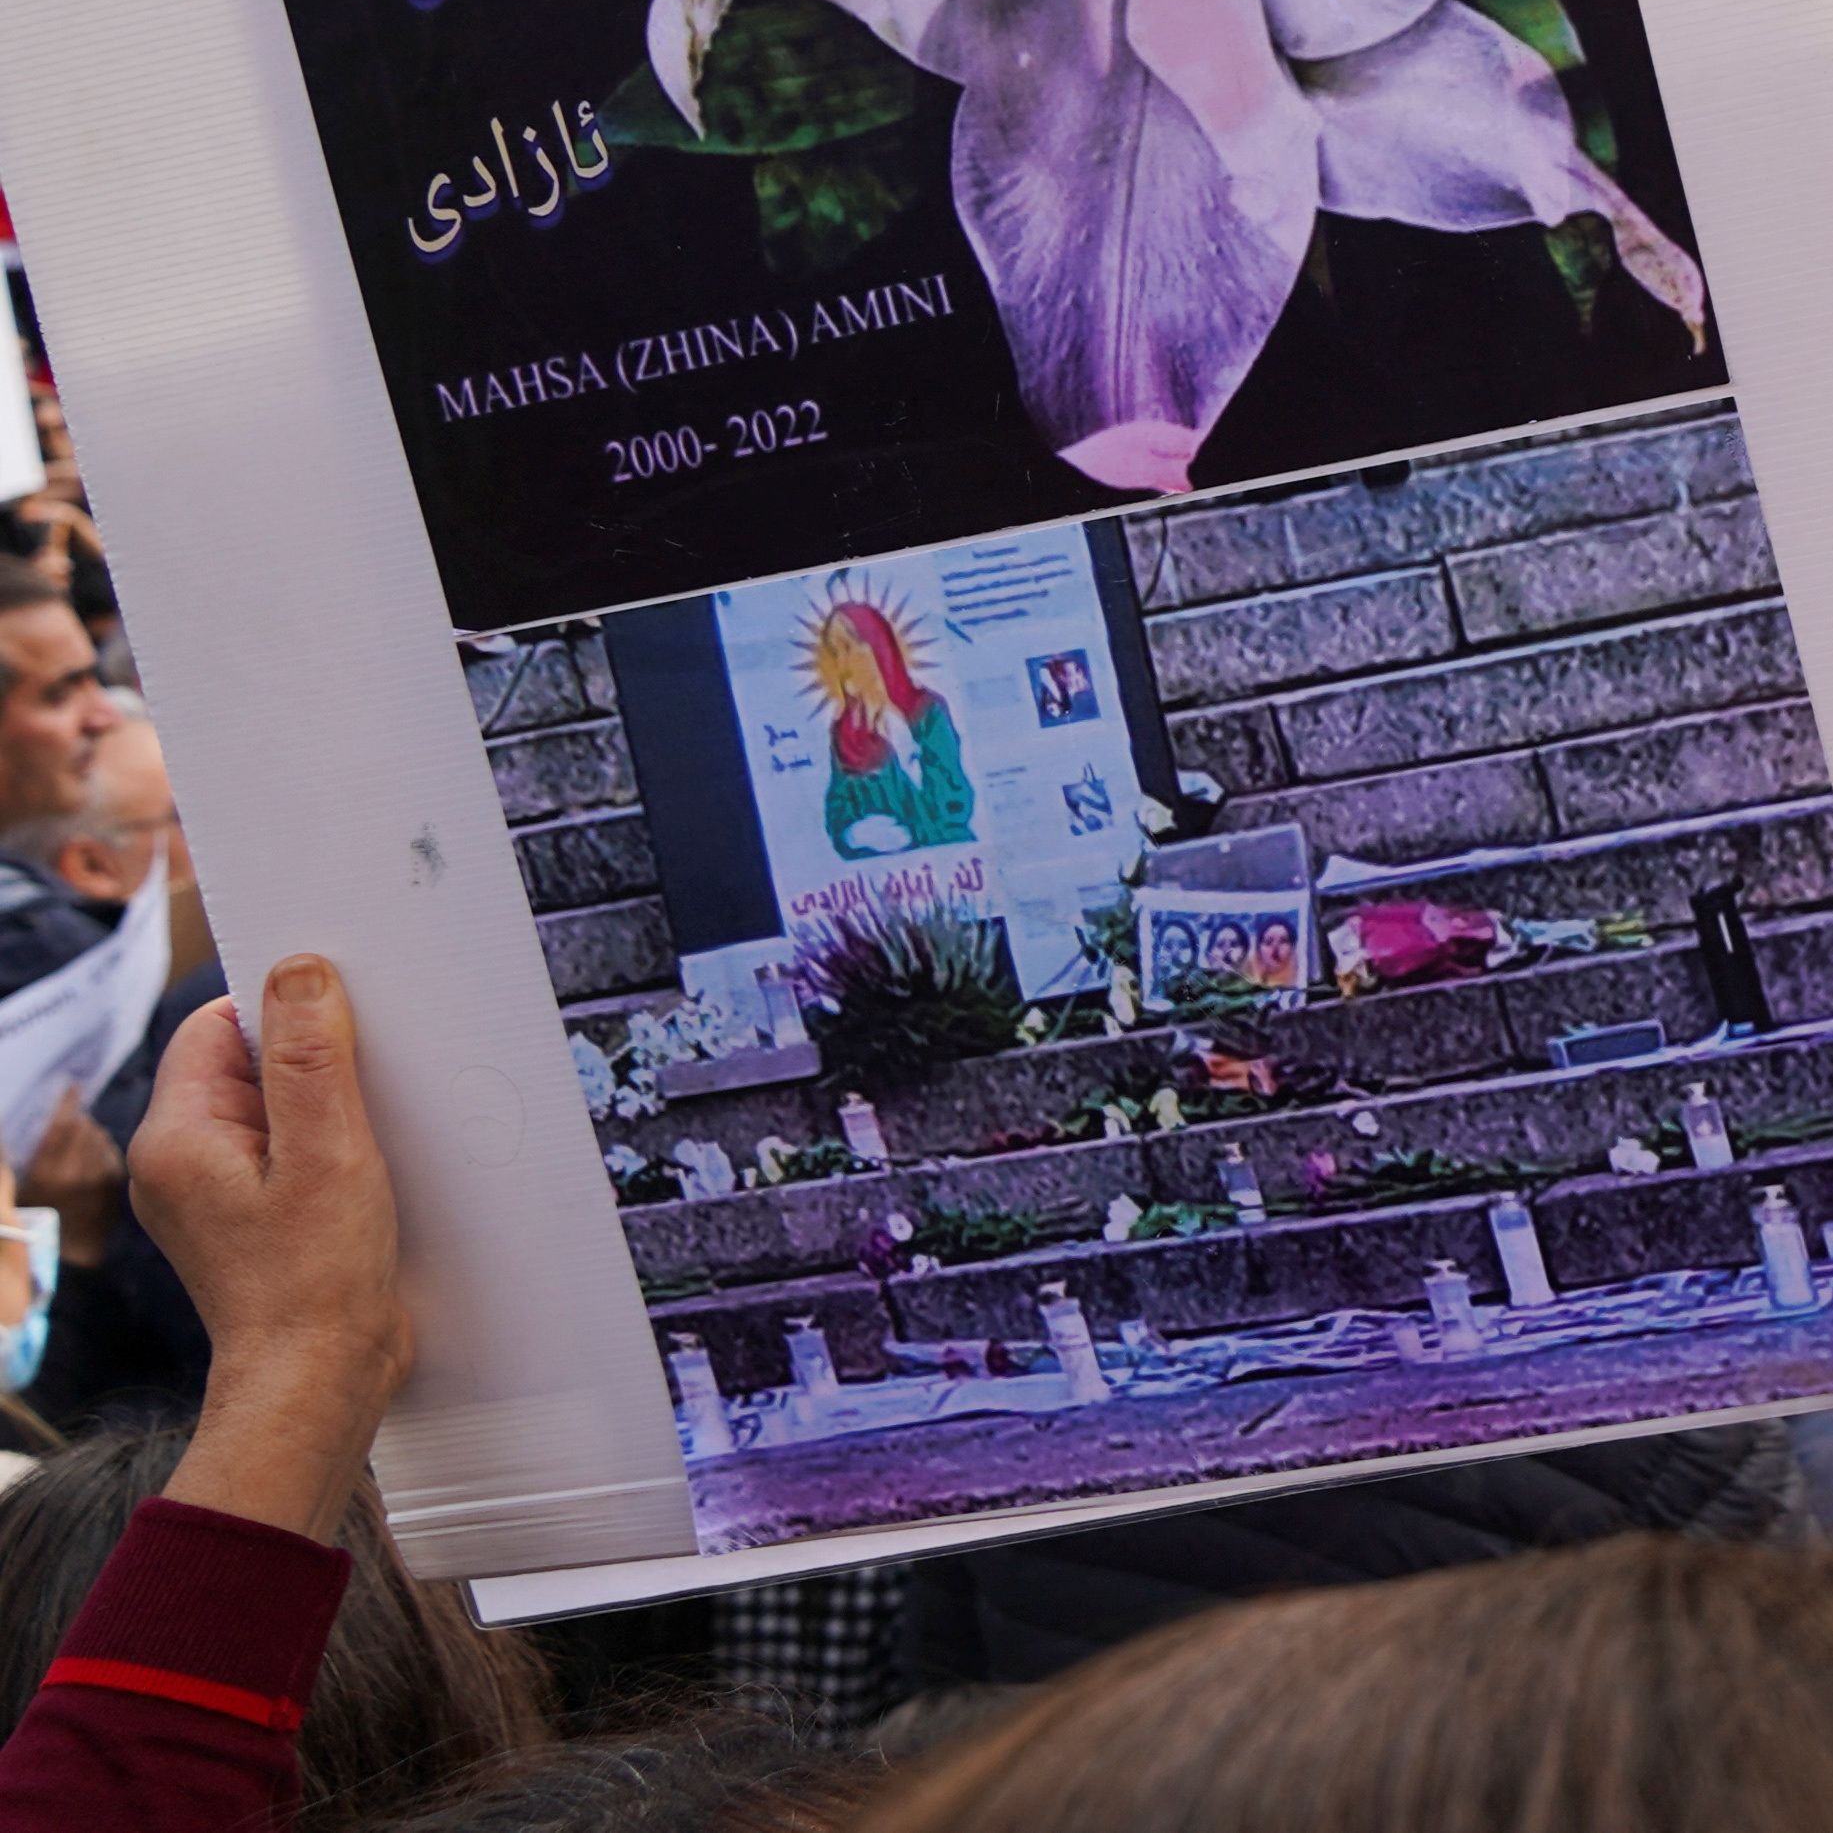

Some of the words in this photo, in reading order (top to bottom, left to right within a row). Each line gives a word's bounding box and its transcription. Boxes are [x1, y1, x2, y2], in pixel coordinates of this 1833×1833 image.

[408, 100, 610, 253] ئازادی
[437, 354, 609, 423] MAHSA
[616, 314, 799, 391] (ZHINA)
[813, 273, 954, 343] AMINI
[606, 428, 717, 484] 2000-
[728, 400, 827, 459] 2022
